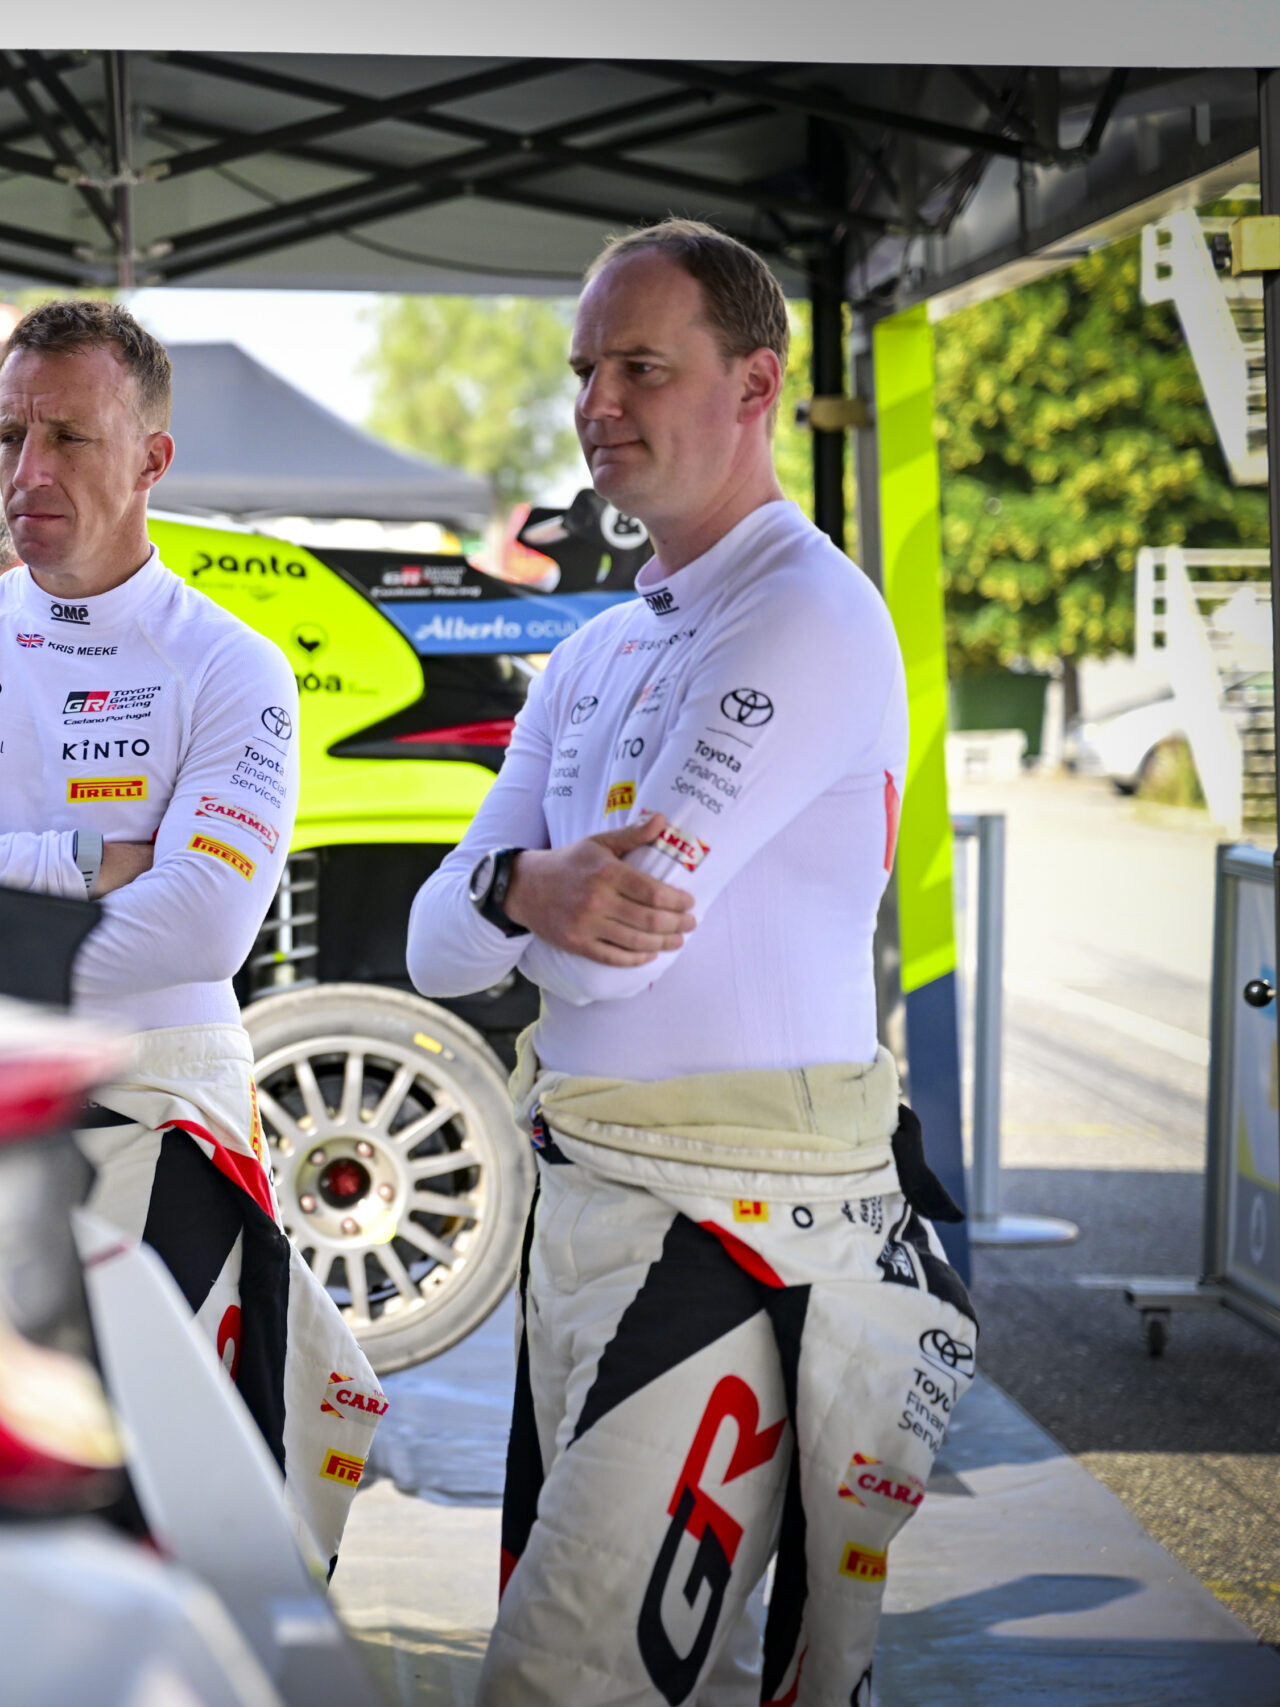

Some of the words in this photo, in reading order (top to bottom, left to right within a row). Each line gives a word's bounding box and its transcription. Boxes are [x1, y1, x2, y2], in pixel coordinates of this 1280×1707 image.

[50, 602, 90, 621] OMP
[415, 614, 521, 640] Alberto
[48, 641, 74, 655] KRIS
[76, 646, 118, 656] MEEKE
[109, 693, 155, 704] GAZOO
[114, 685, 162, 697] TOYOTA
[63, 716, 105, 726] Caetano
[106, 711, 152, 723] Portugal
[64, 698, 105, 713] GR
[107, 700, 152, 711] Racing
[244, 745, 285, 776] Toyota
[694, 739, 742, 773] Toyota
[70, 780, 144, 799] PIRELLI
[230, 773, 281, 809] Services
[235, 760, 287, 799] Financial
[682, 758, 742, 799] Financial
[671, 776, 723, 815] Services
[204, 803, 273, 842] CARAMEL
[192, 836, 253, 877] PIRELLI
[637, 1374, 788, 1707] GR
